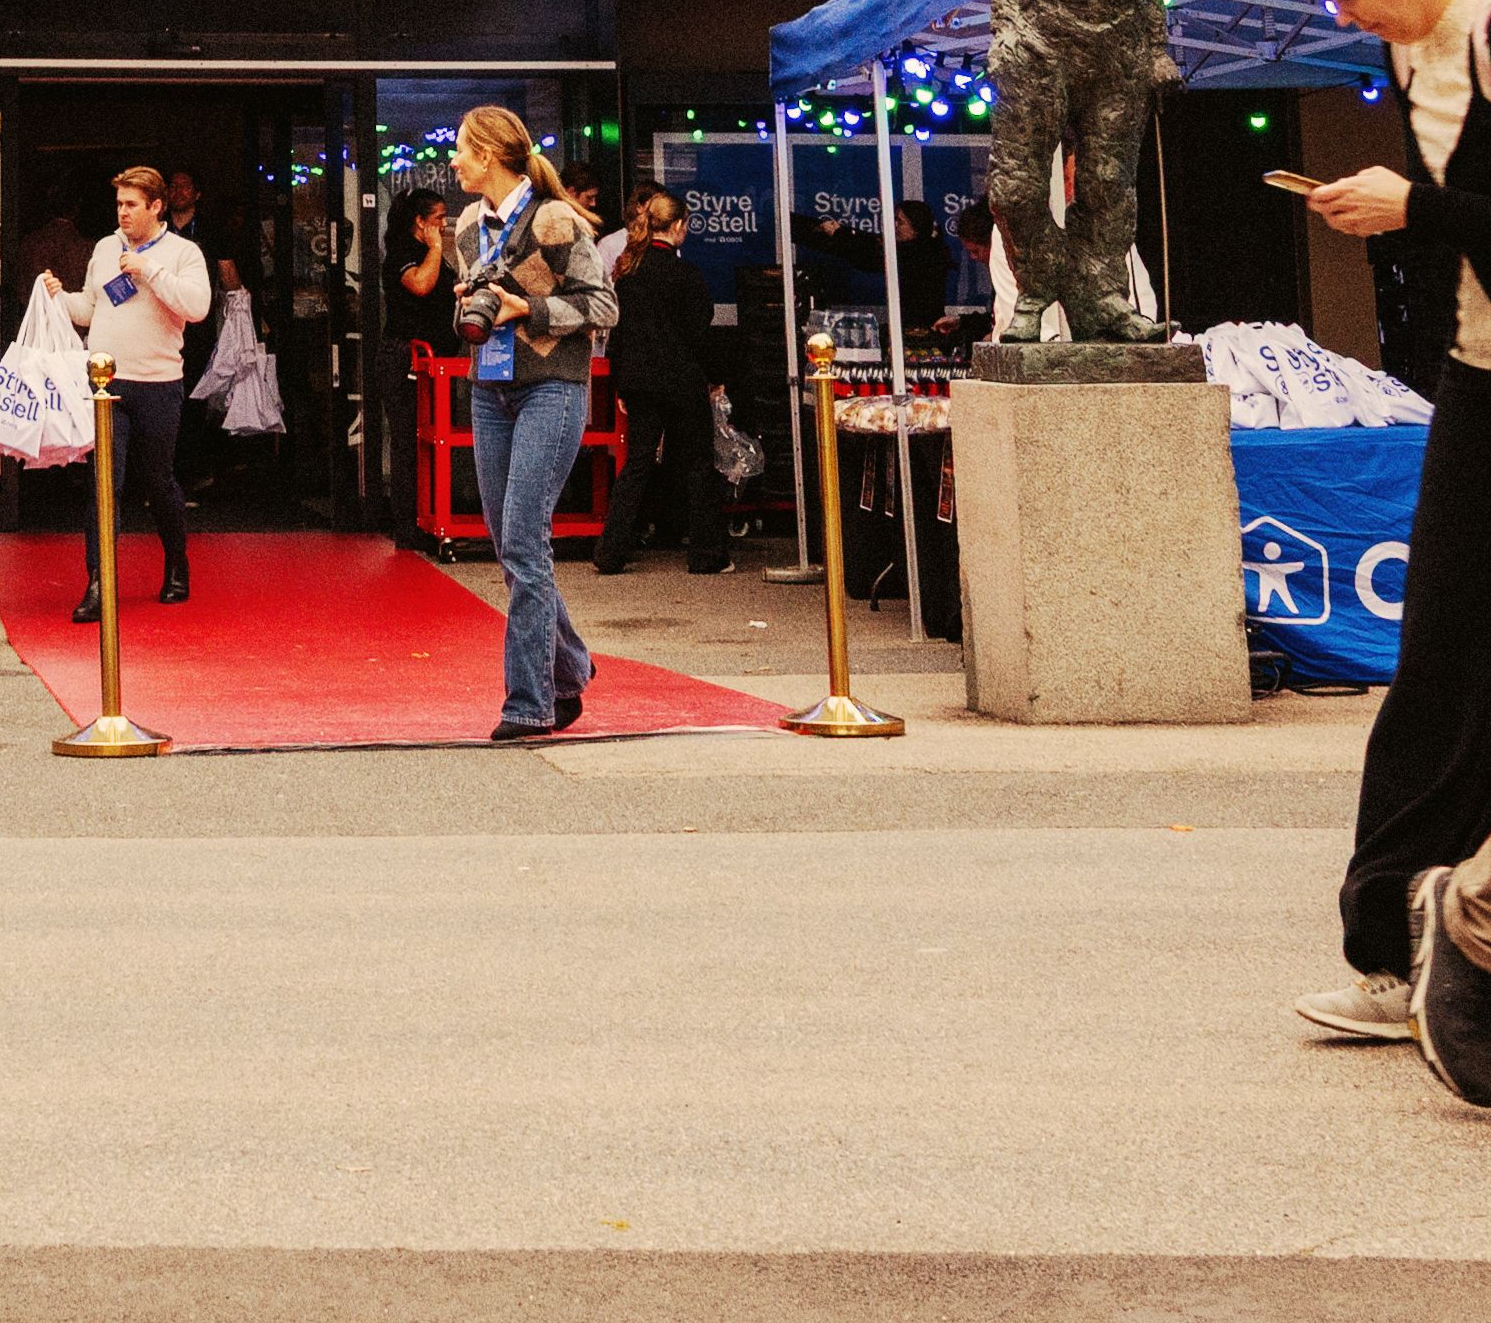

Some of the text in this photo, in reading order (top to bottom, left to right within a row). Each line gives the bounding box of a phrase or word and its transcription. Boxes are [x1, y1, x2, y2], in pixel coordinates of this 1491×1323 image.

[685, 189, 753, 216] Styre
[814, 191, 881, 216] Styre
[708, 211, 758, 233] stell
